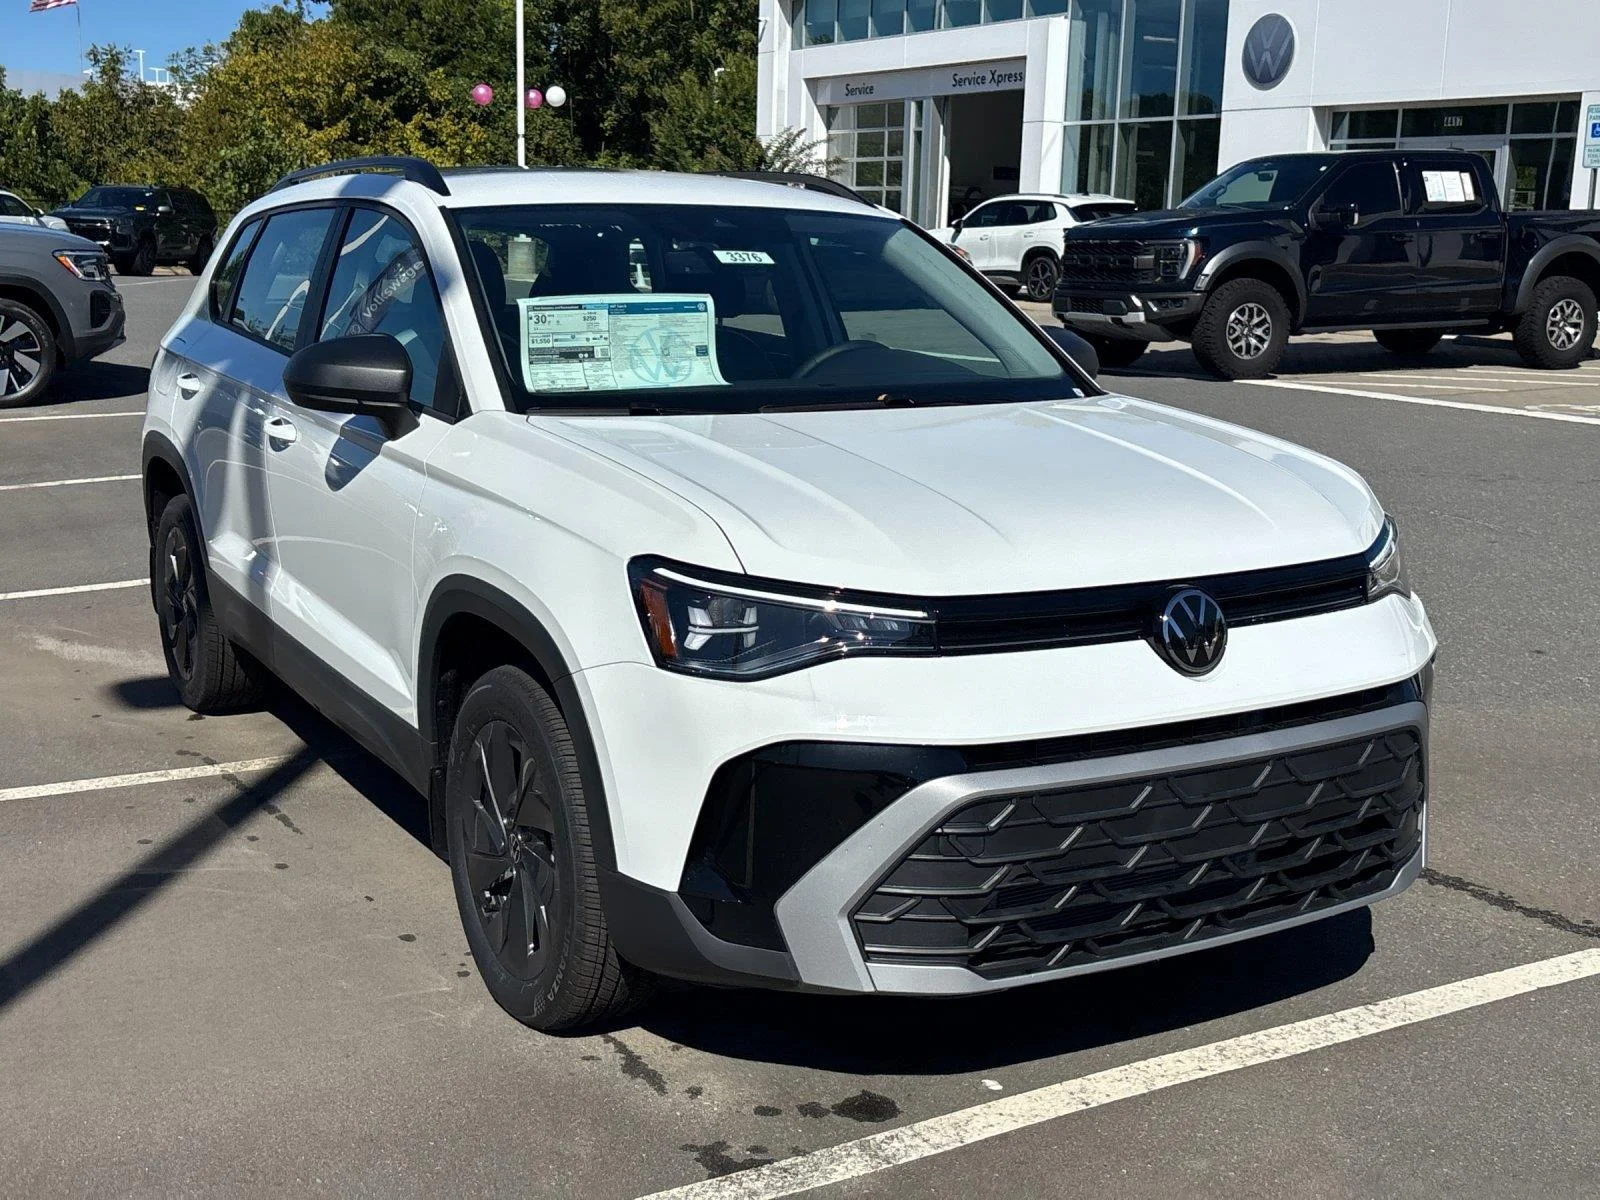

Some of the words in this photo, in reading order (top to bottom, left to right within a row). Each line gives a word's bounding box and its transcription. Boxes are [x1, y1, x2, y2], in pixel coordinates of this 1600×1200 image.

[952, 71, 986, 88] Service
[989, 69, 1023, 87] Xpress
[845, 83, 874, 97] Service
[726, 252, 763, 263] 3376
[533, 314, 547, 325] 30
